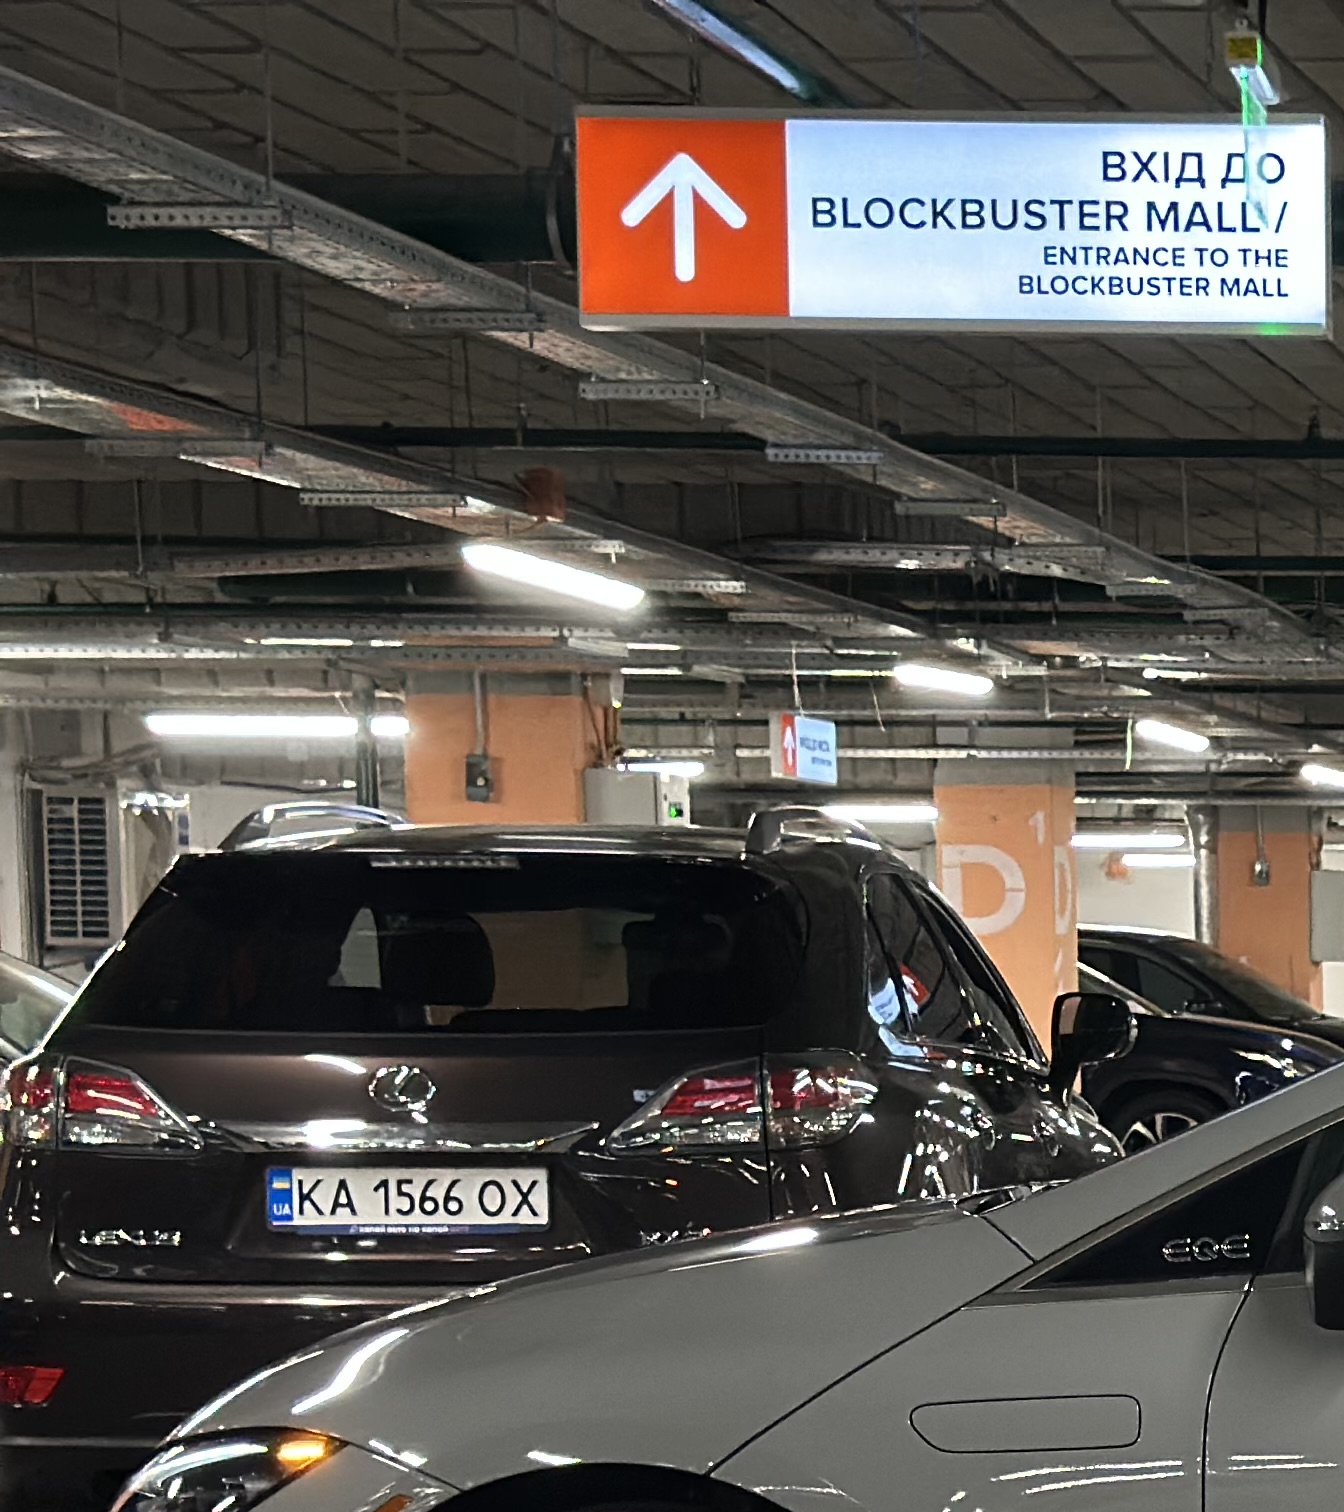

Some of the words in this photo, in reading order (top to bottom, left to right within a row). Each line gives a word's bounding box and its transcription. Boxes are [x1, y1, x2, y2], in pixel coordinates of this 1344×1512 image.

[1102, 151, 1206, 189] ВХІД
[1221, 152, 1286, 189] ДО
[811, 196, 1129, 231] BLOCKBUSTER
[1146, 200, 1261, 233] MALL
[1043, 246, 1186, 267] ENTRANCE
[1194, 247, 1230, 267] TO
[1238, 248, 1289, 268] THE
[1018, 274, 1210, 297] BLOCKBUSTER
[1219, 276, 1289, 298] MALL
[942, 843, 1026, 936] D
[273, 1205, 291, 1216] UA
[297, 1178, 358, 1217] KA
[372, 1178, 465, 1217] 1566
[477, 1178, 540, 1217] OX
[1162, 1233, 1251, 1263] EQE
